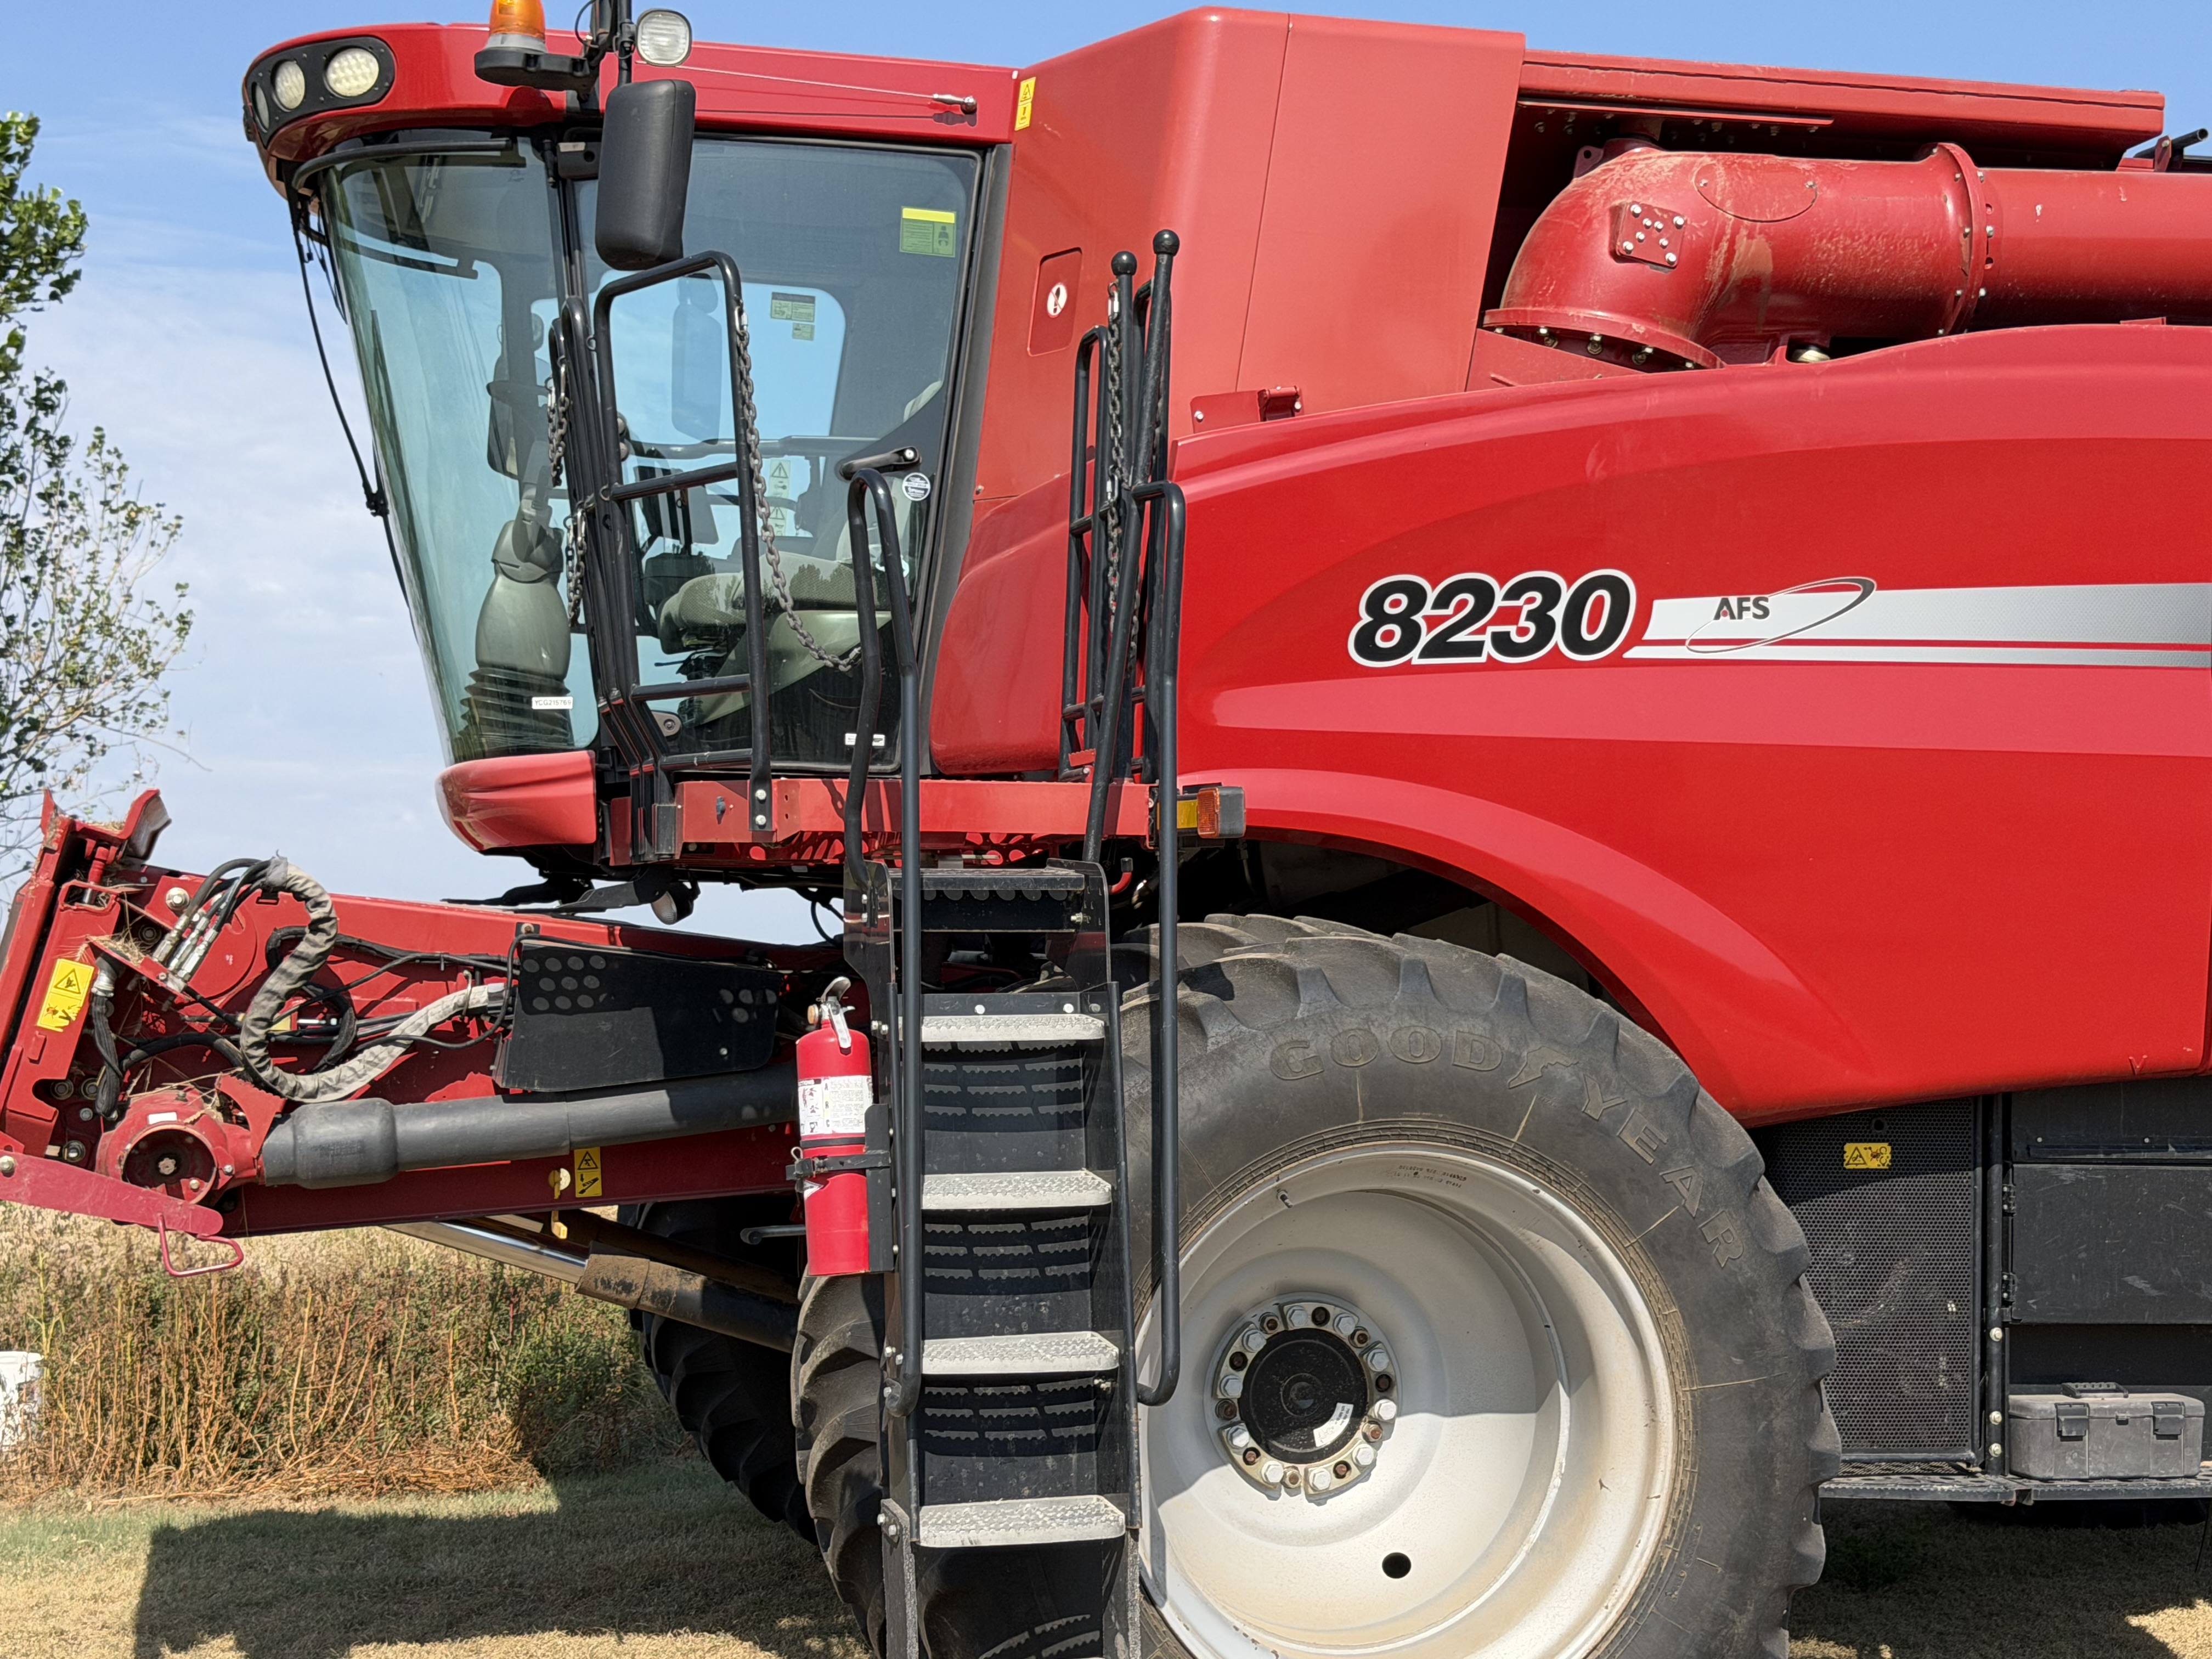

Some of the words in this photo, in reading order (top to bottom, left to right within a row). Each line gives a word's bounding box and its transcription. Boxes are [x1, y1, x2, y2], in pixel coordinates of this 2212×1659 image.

[1348, 569, 1636, 667] 8230
[1713, 596, 1770, 620] AFS
[1269, 1025, 1745, 1267] GOODYEAR
